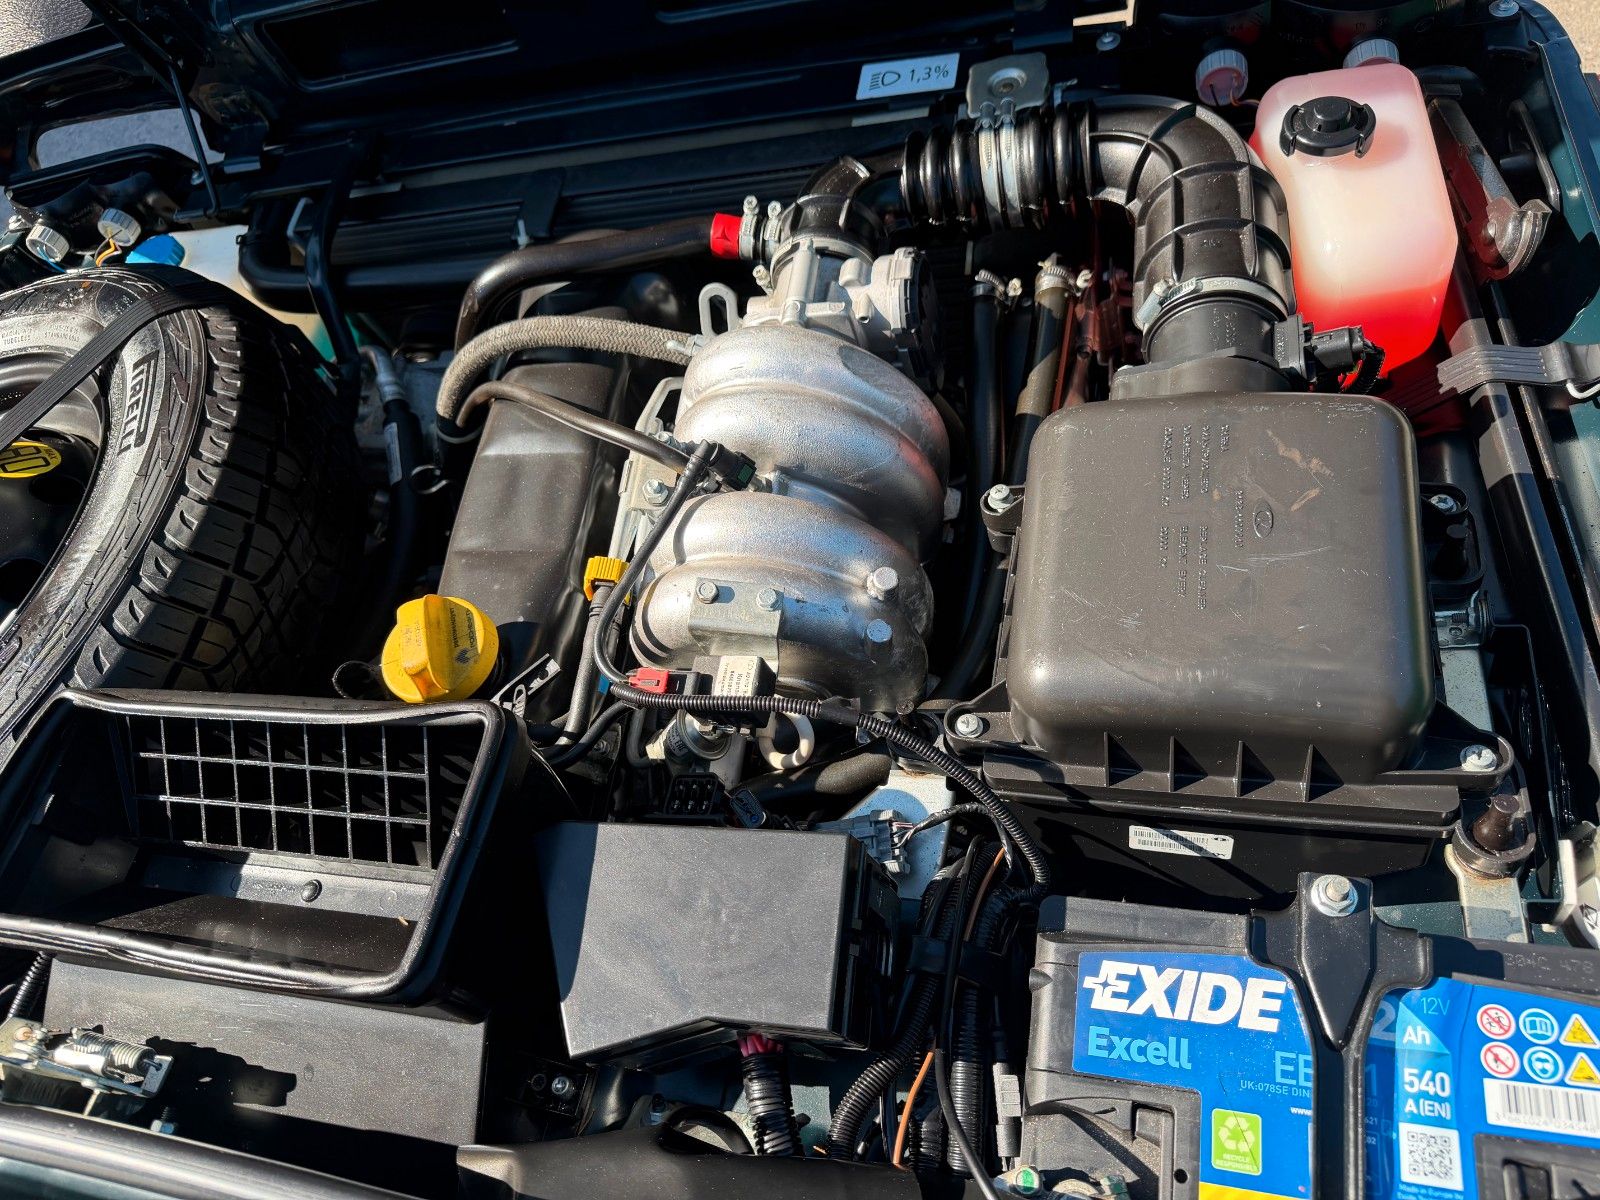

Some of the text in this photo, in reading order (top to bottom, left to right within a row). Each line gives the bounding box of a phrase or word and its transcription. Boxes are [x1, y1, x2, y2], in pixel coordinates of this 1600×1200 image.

[909, 64, 949, 84] 1,3%
[117, 350, 160, 457] PIRELLI
[1083, 960, 1287, 1033] EXIDE
[1421, 997, 1450, 1016] 12V
[1087, 1025, 1192, 1070] Excell
[1403, 1025, 1431, 1045] Ah
[1240, 1080, 1310, 1098] UK:078SE DIN
[1404, 1067, 1451, 1098] 540
